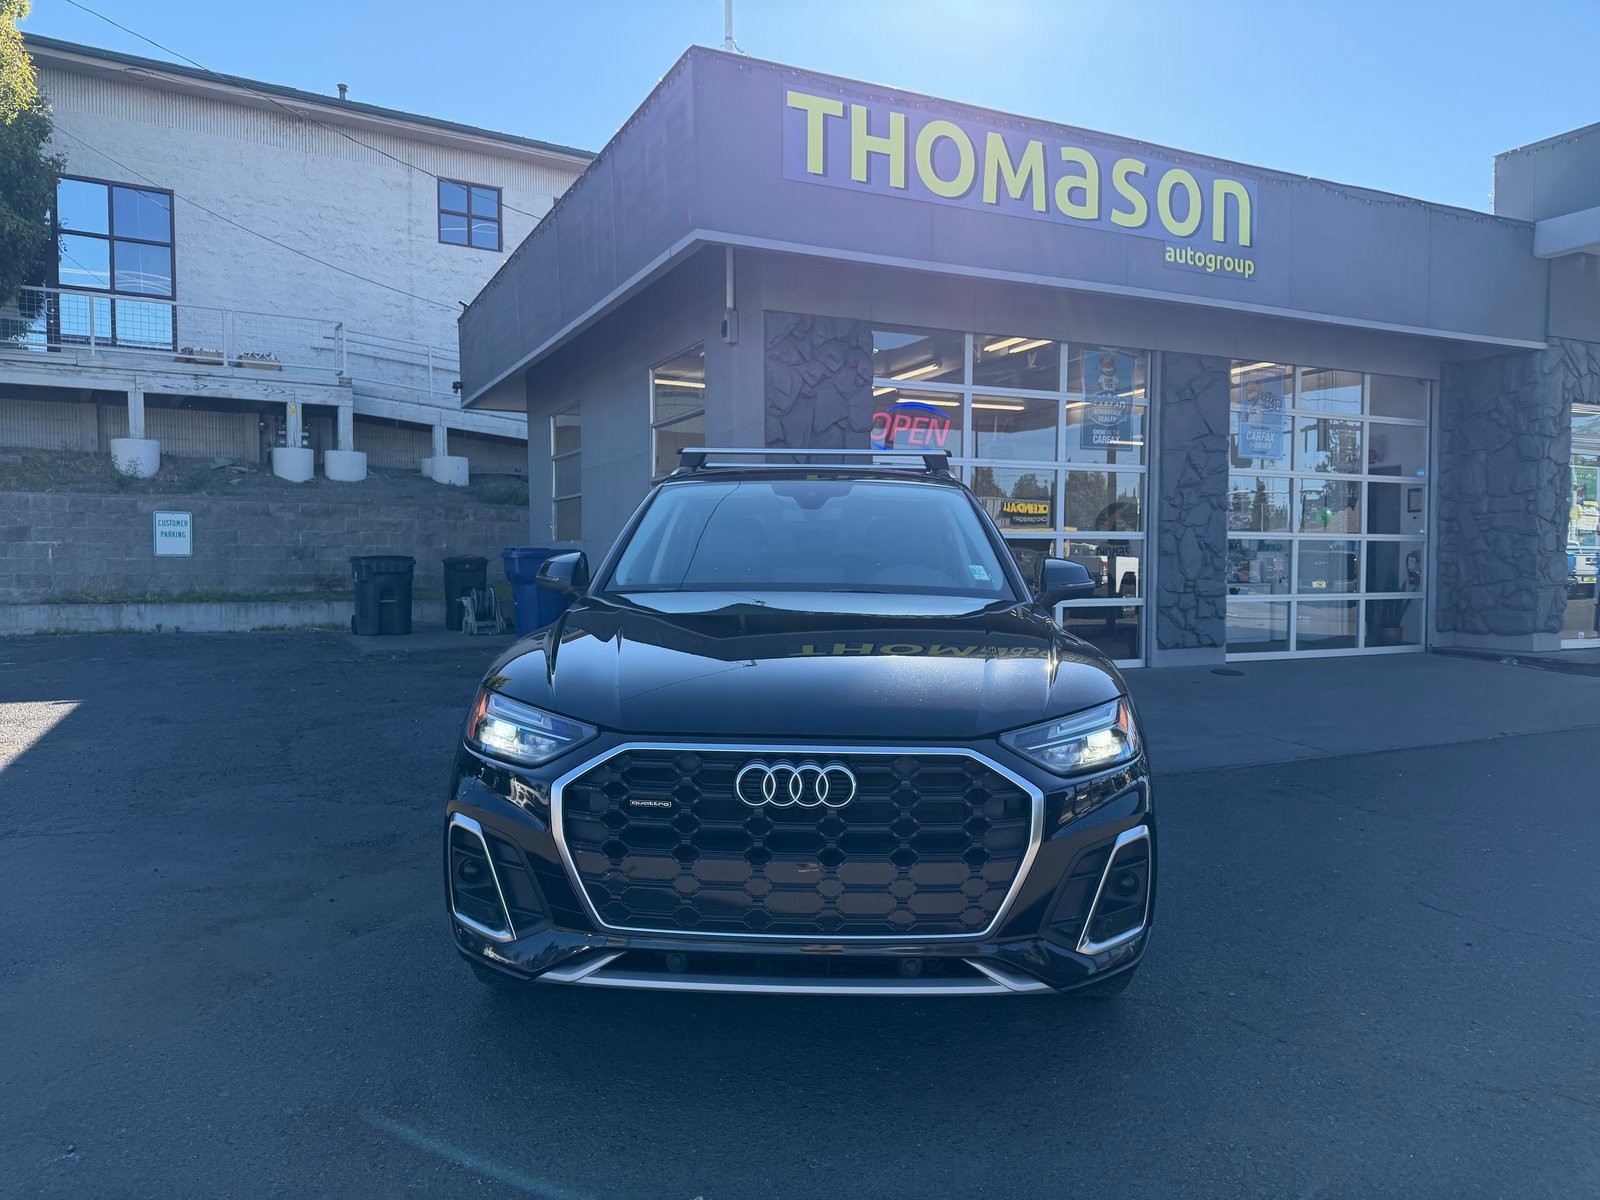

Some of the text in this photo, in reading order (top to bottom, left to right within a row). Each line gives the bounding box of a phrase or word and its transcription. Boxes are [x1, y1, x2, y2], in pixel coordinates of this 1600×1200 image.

[1164, 245, 1255, 278] autogroup
[871, 411, 951, 447] OPEN
[1092, 435, 1120, 444] CARFAX
[1246, 431, 1275, 442] CARFAX
